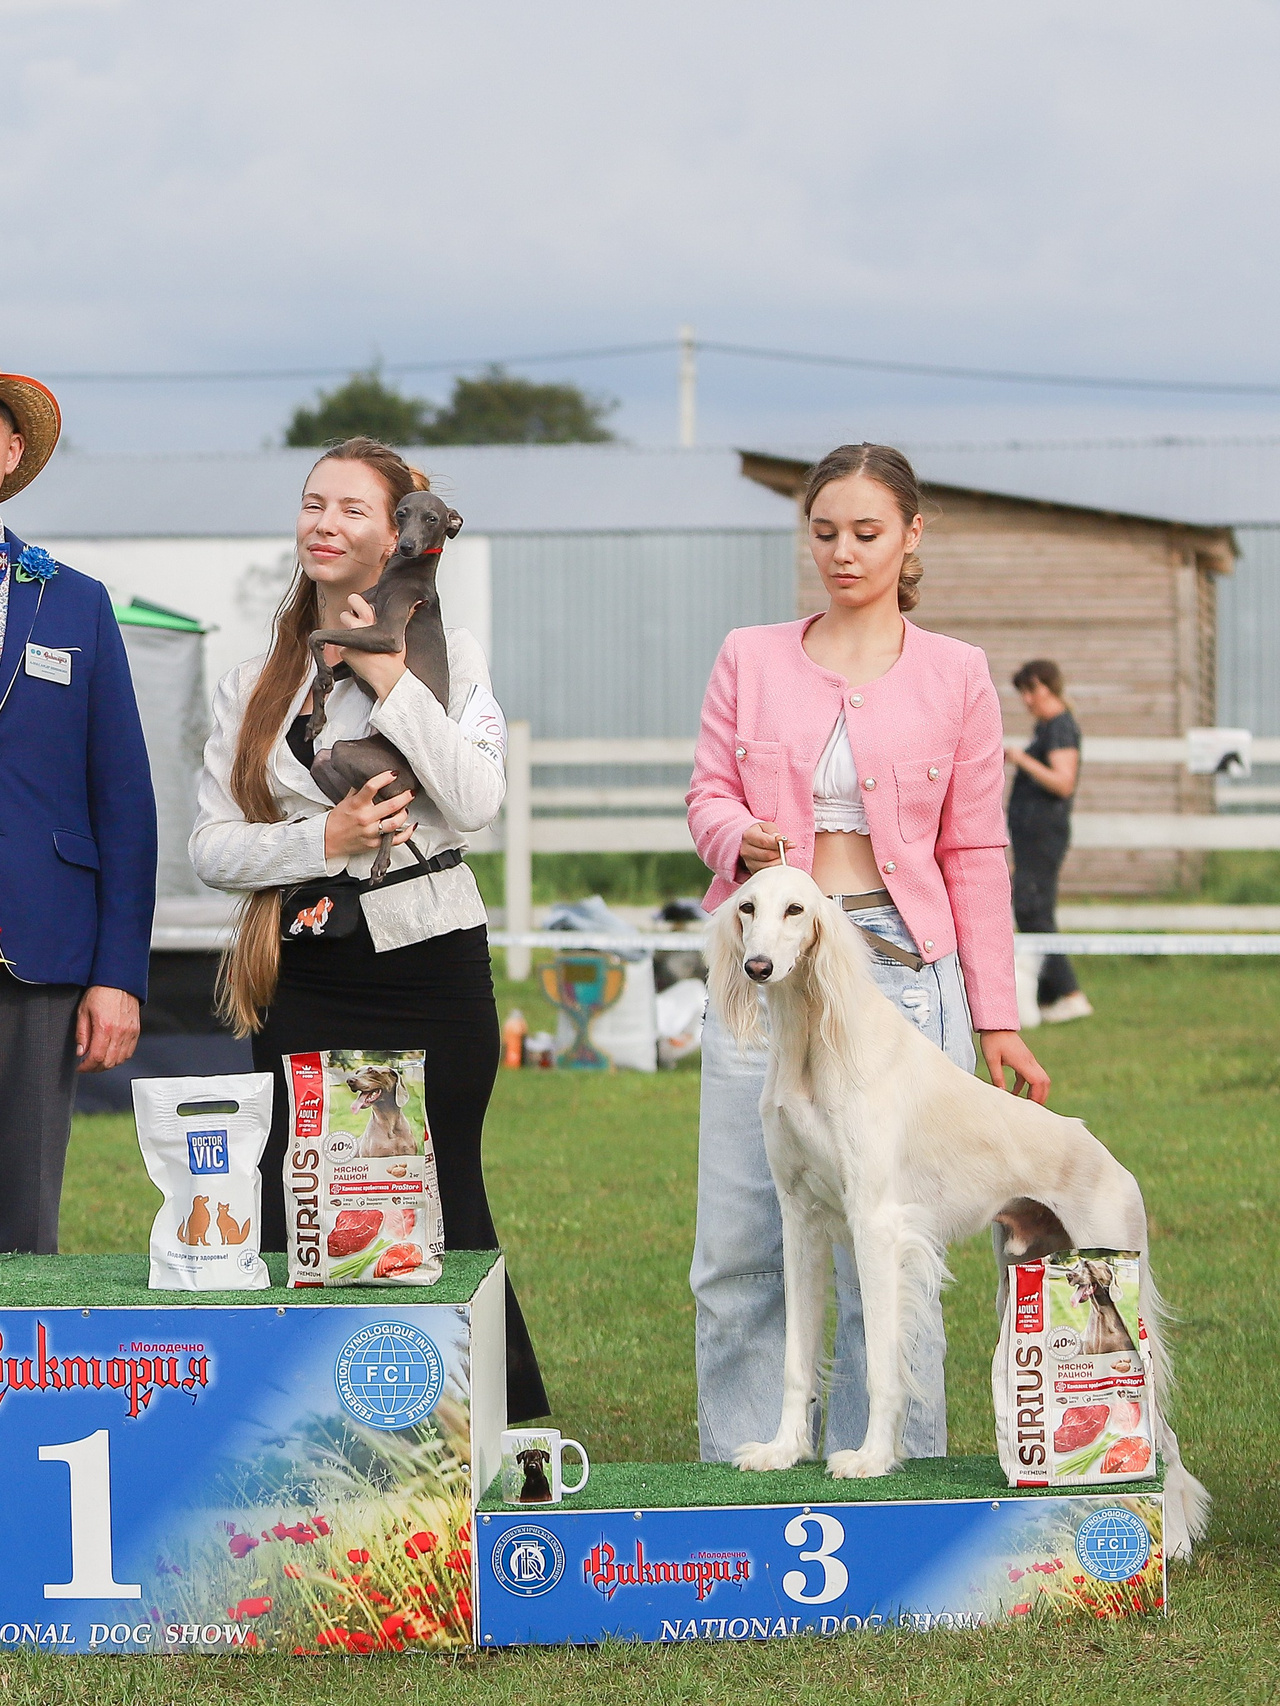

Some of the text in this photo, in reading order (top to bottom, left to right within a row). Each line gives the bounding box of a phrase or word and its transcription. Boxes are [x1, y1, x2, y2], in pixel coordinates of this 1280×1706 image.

[477, 738, 499, 761] Brit
[298, 1109, 319, 1120] ADULT
[191, 1135, 223, 1147] DOCTOR
[330, 1141, 353, 1152] 40%
[193, 1145, 225, 1169] VIC
[333, 1164, 369, 1174] МЯСНОЙ
[333, 1173, 368, 1181] РАЦИОН
[292, 1149, 321, 1268] SIRIUS
[1017, 1304, 1039, 1315] ADULT
[130, 1341, 206, 1355] Молодечно
[1052, 1337, 1076, 1349] 40%
[338, 1324, 440, 1421] FEDERATION CYNOLOGIQUE INTERNATIONALE
[365, 1365, 411, 1383] FCI
[1057, 1361, 1094, 1371] МЯСНОЙ
[1058, 1371, 1093, 1379] РАЦИОН
[1015, 1345, 1046, 1466] SIRIUS
[37, 1428, 142, 1600] 1
[1078, 1510, 1147, 1576] FEDERATION CYNOLOGIQUE INTERNATIONALE
[1097, 1537, 1127, 1551] FCI
[698, 1551, 747, 1560] Молодечно
[782, 1511, 850, 1606] 3
[584, 1532, 751, 1602] Виктория
[88, 1623, 153, 1645] DOG
[164, 1623, 252, 1645] SHOW
[660, 1616, 802, 1641] NATIONAL
